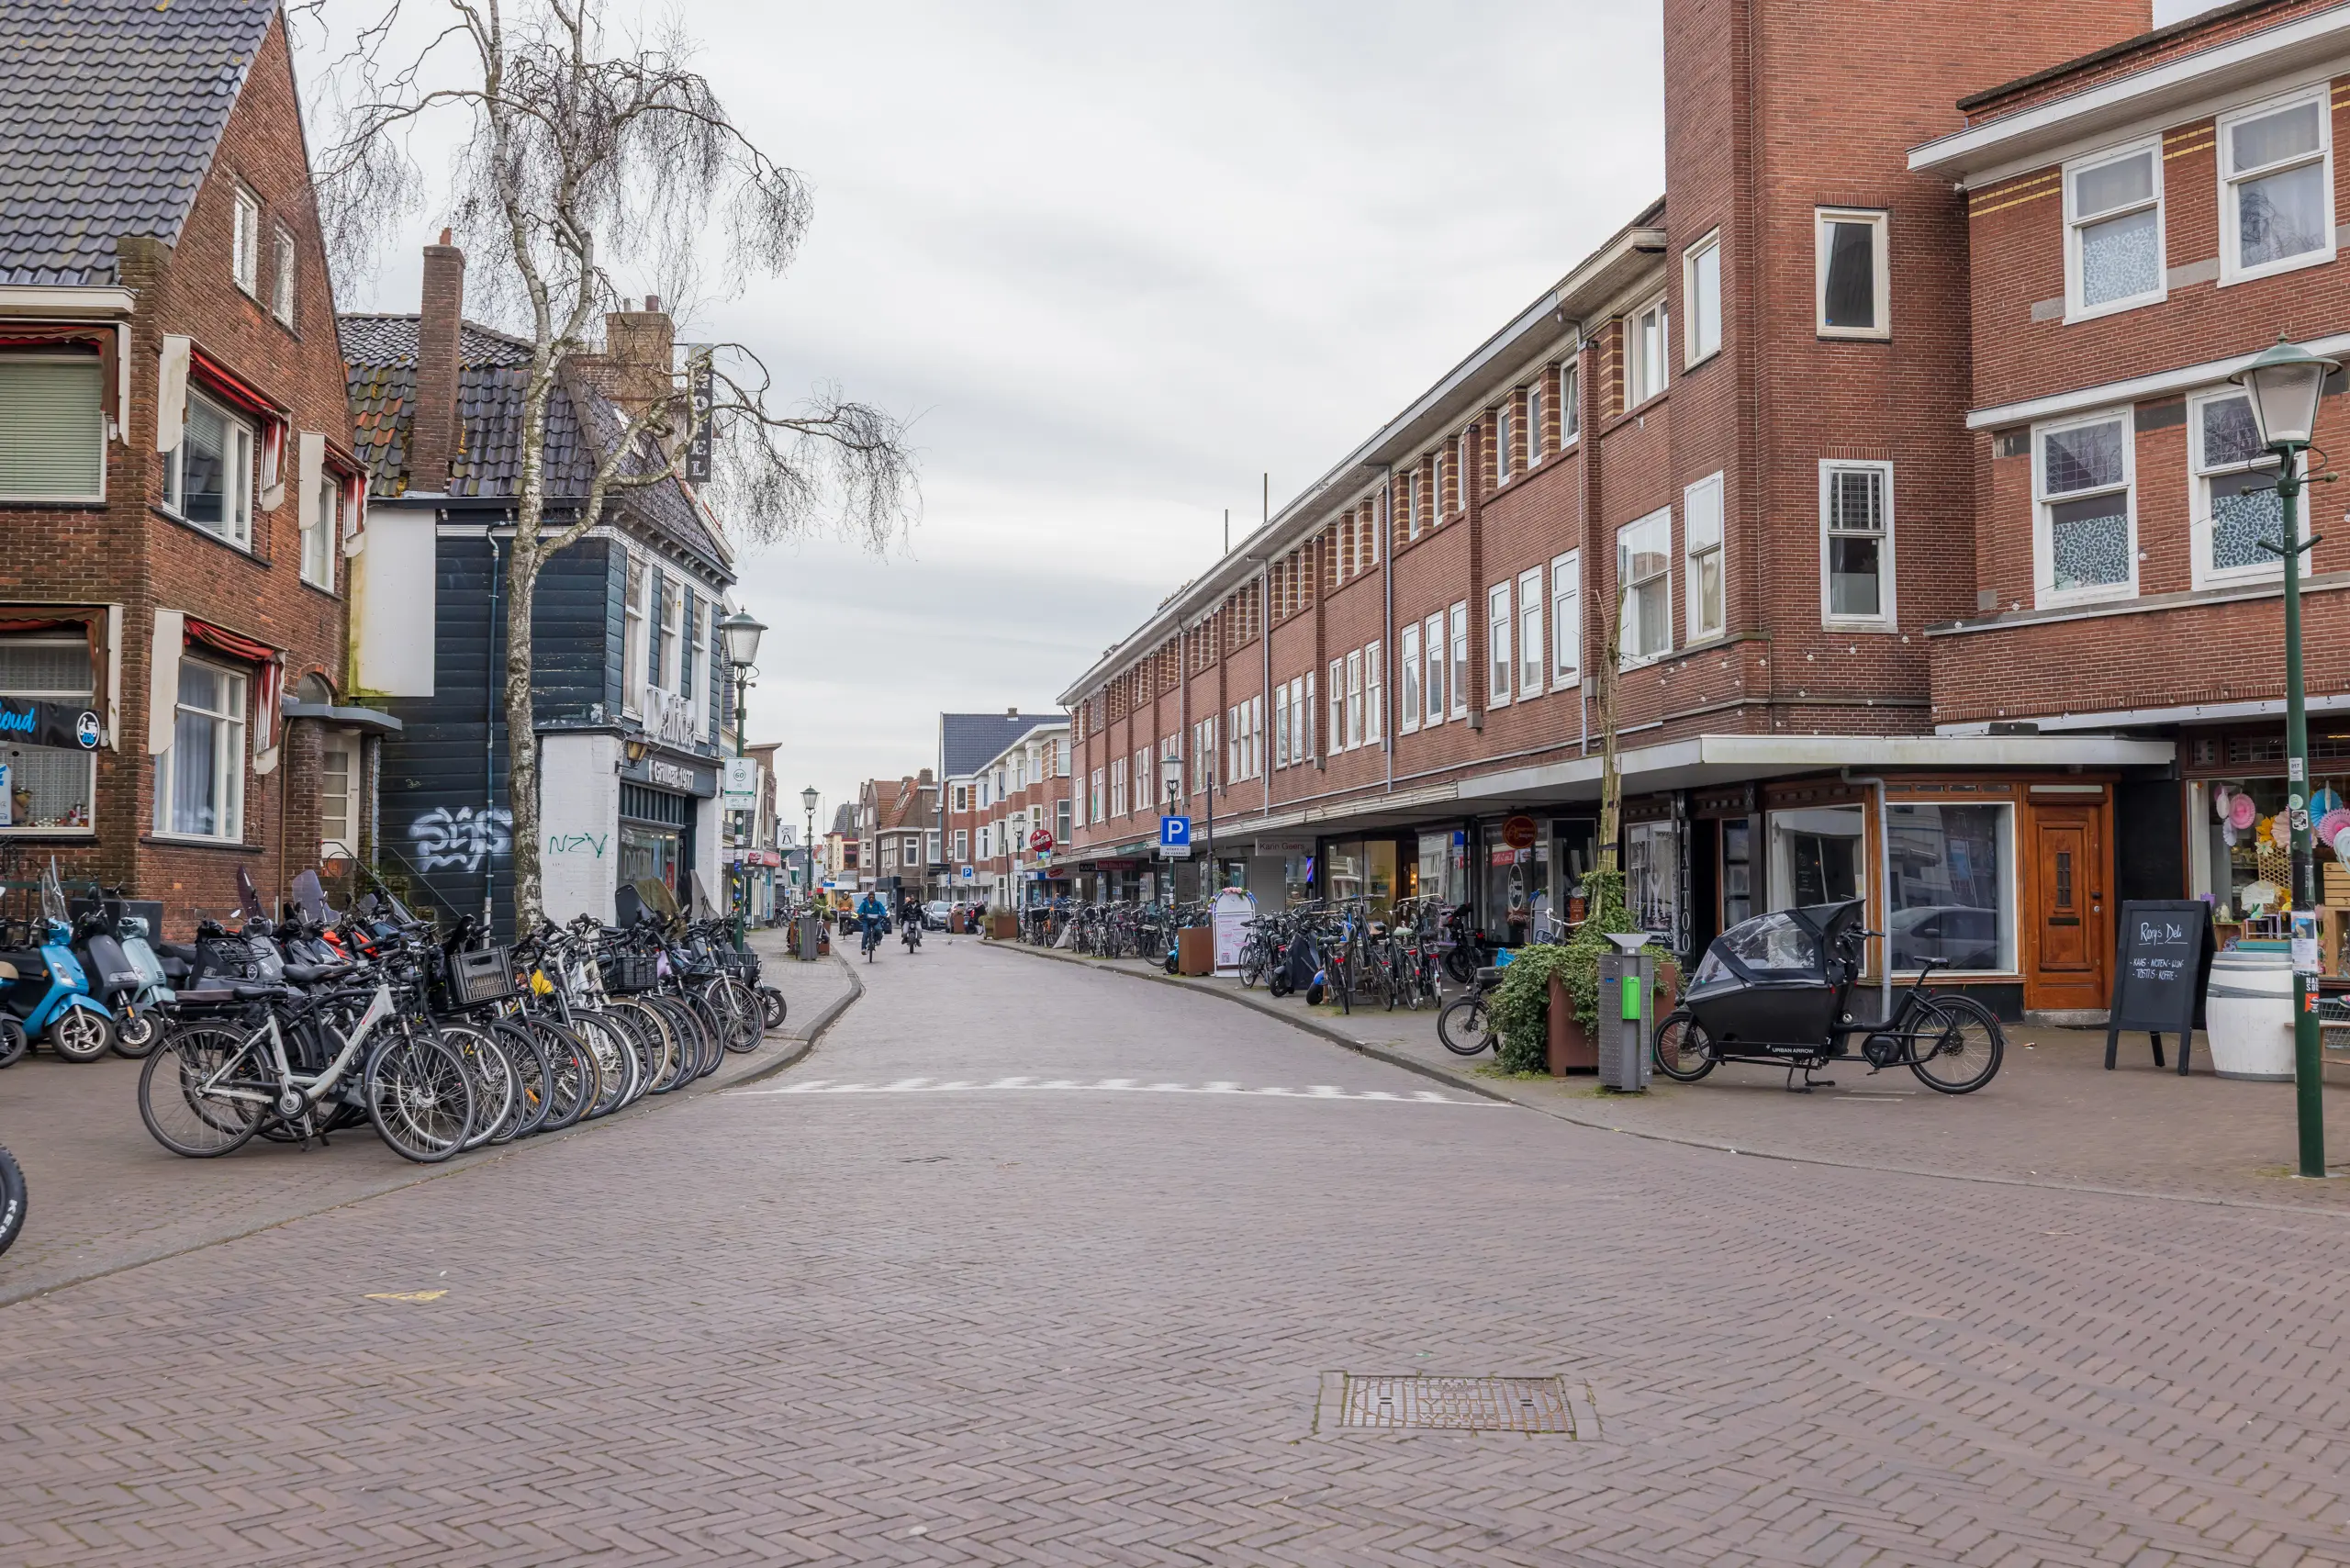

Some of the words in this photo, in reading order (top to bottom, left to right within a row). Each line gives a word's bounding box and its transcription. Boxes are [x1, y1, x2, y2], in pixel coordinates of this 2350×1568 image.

[655, 760, 678, 785] Grillbar
[678, 767, 694, 790] 1977
[1168, 820, 1184, 843] P
[1681, 826, 1691, 952] TATTOO
[2165, 923, 2183, 944] Deli
